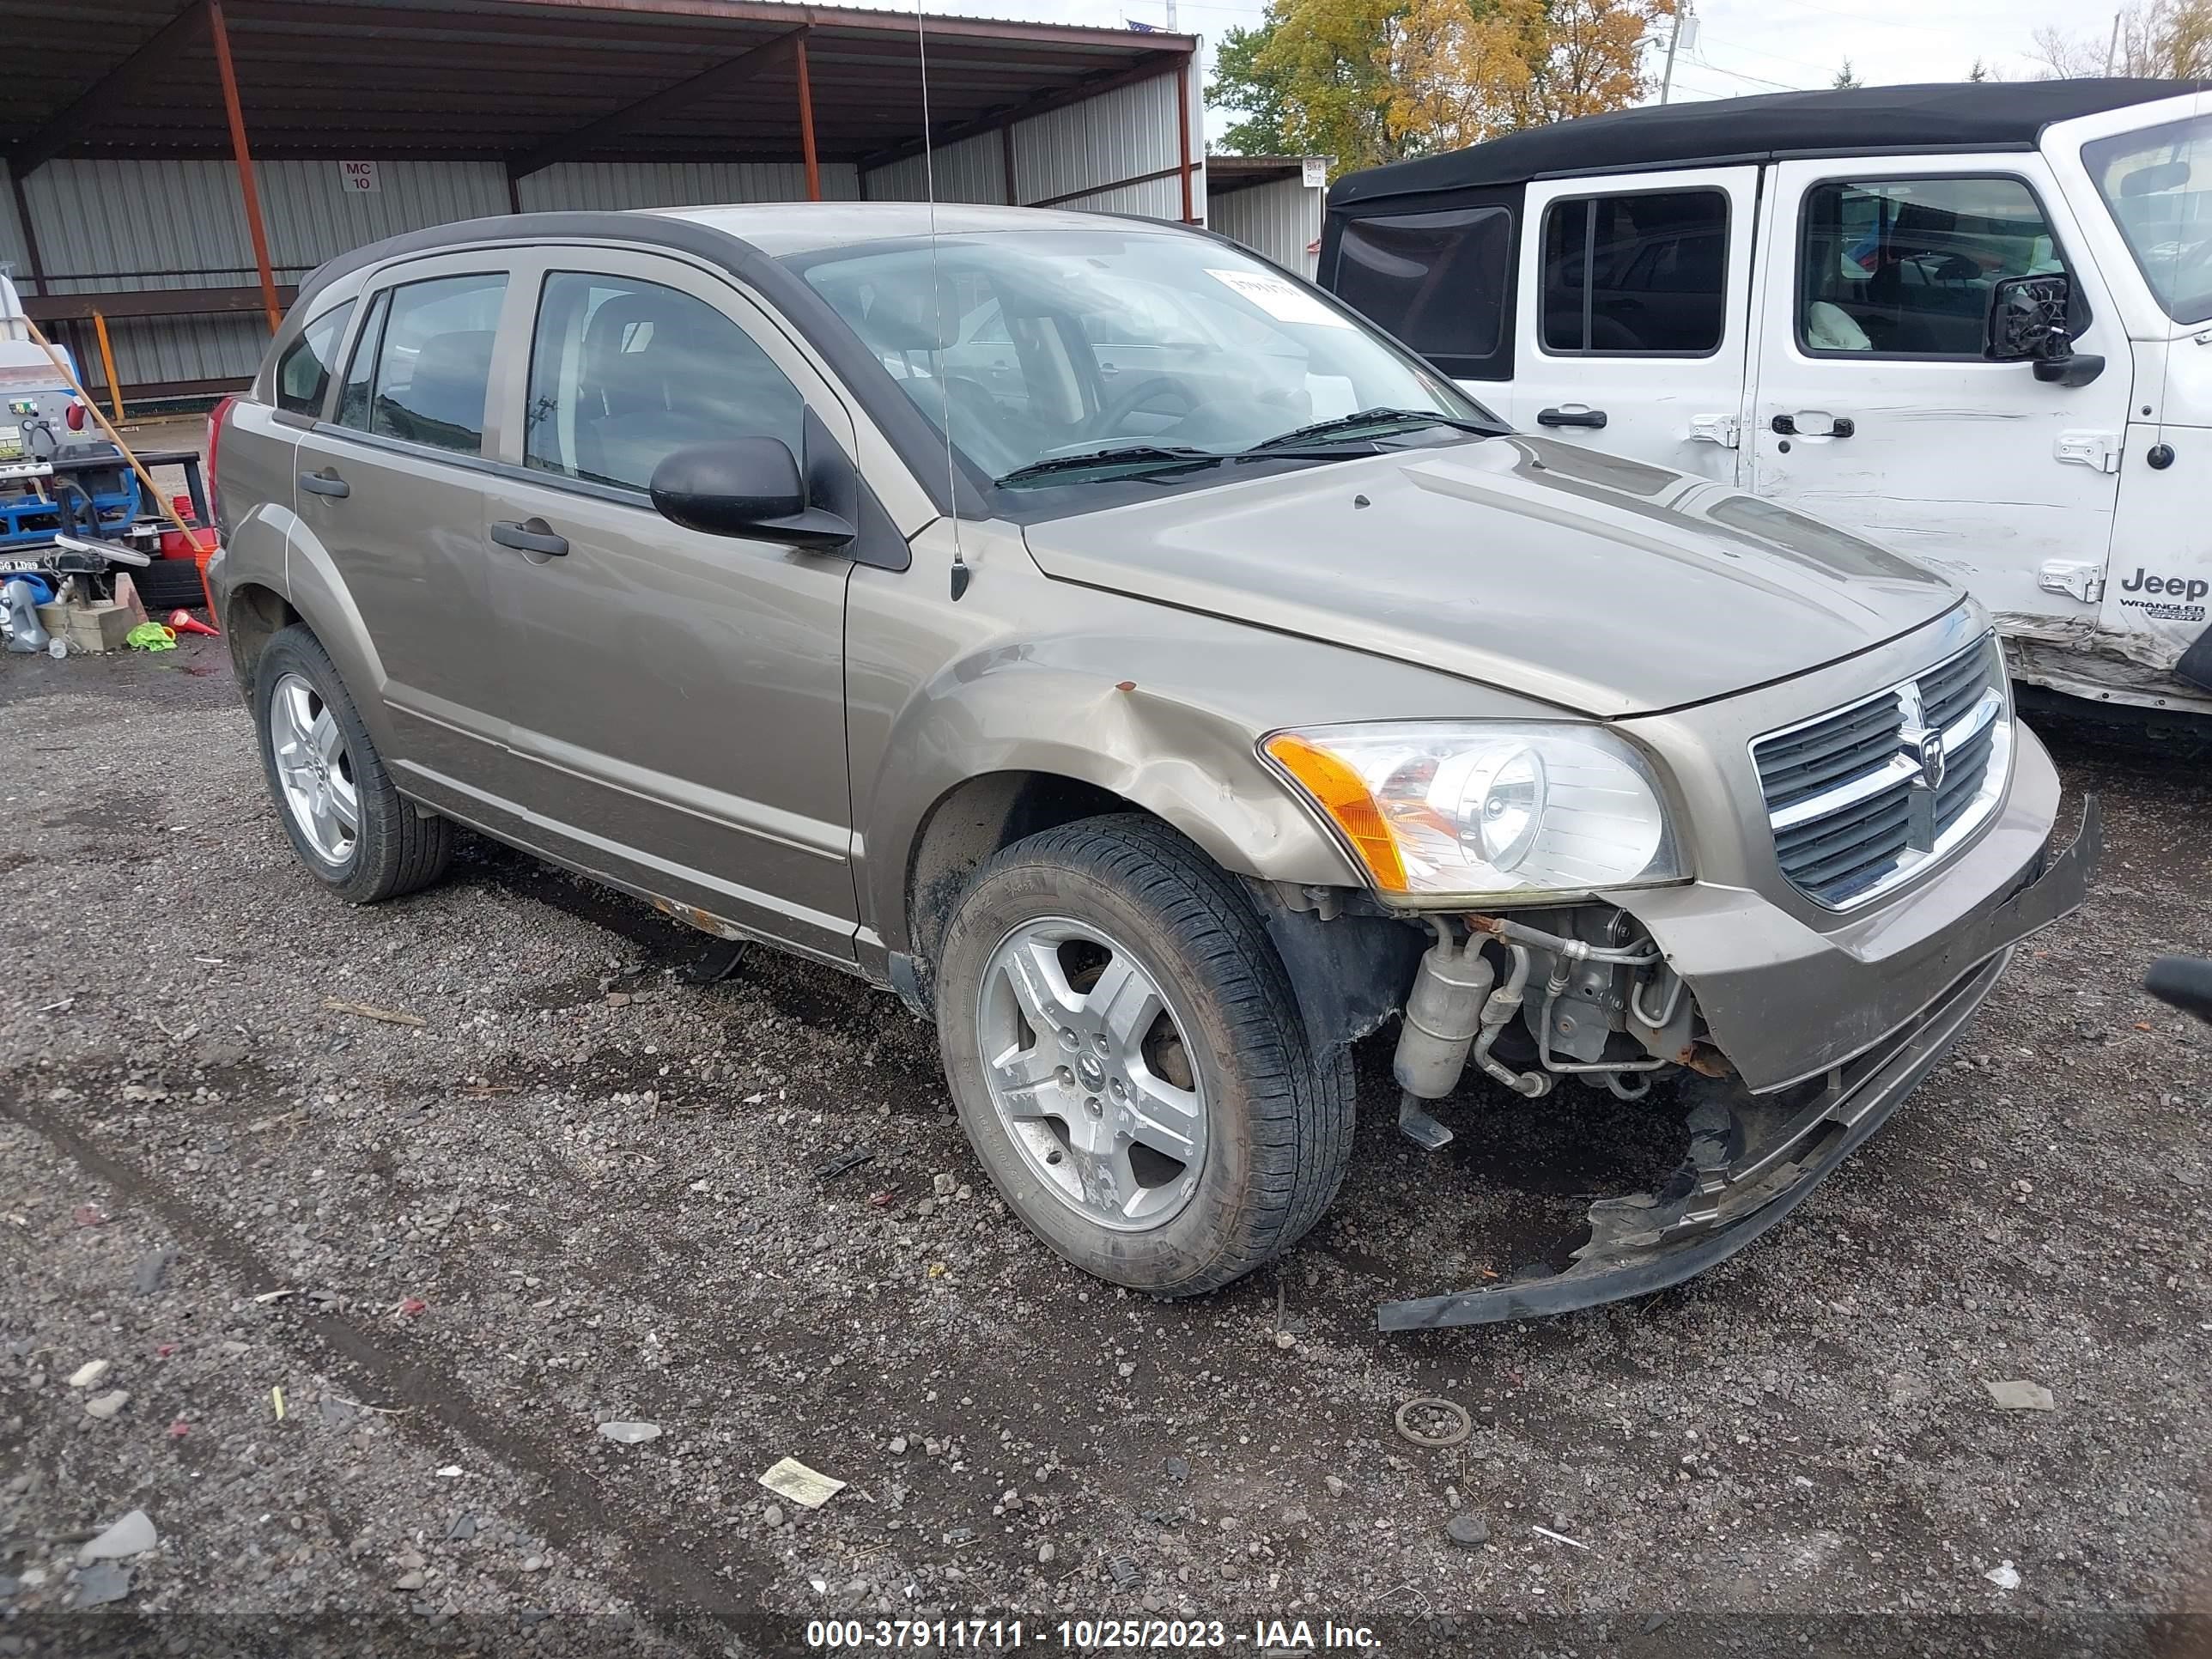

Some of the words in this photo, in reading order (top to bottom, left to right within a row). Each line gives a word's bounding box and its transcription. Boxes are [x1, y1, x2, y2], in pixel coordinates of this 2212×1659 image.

[346, 163, 371, 174] MC
[352, 178, 370, 189] 10
[2122, 567, 2209, 602] Jeep
[2119, 598, 2205, 612] WRANGLER
